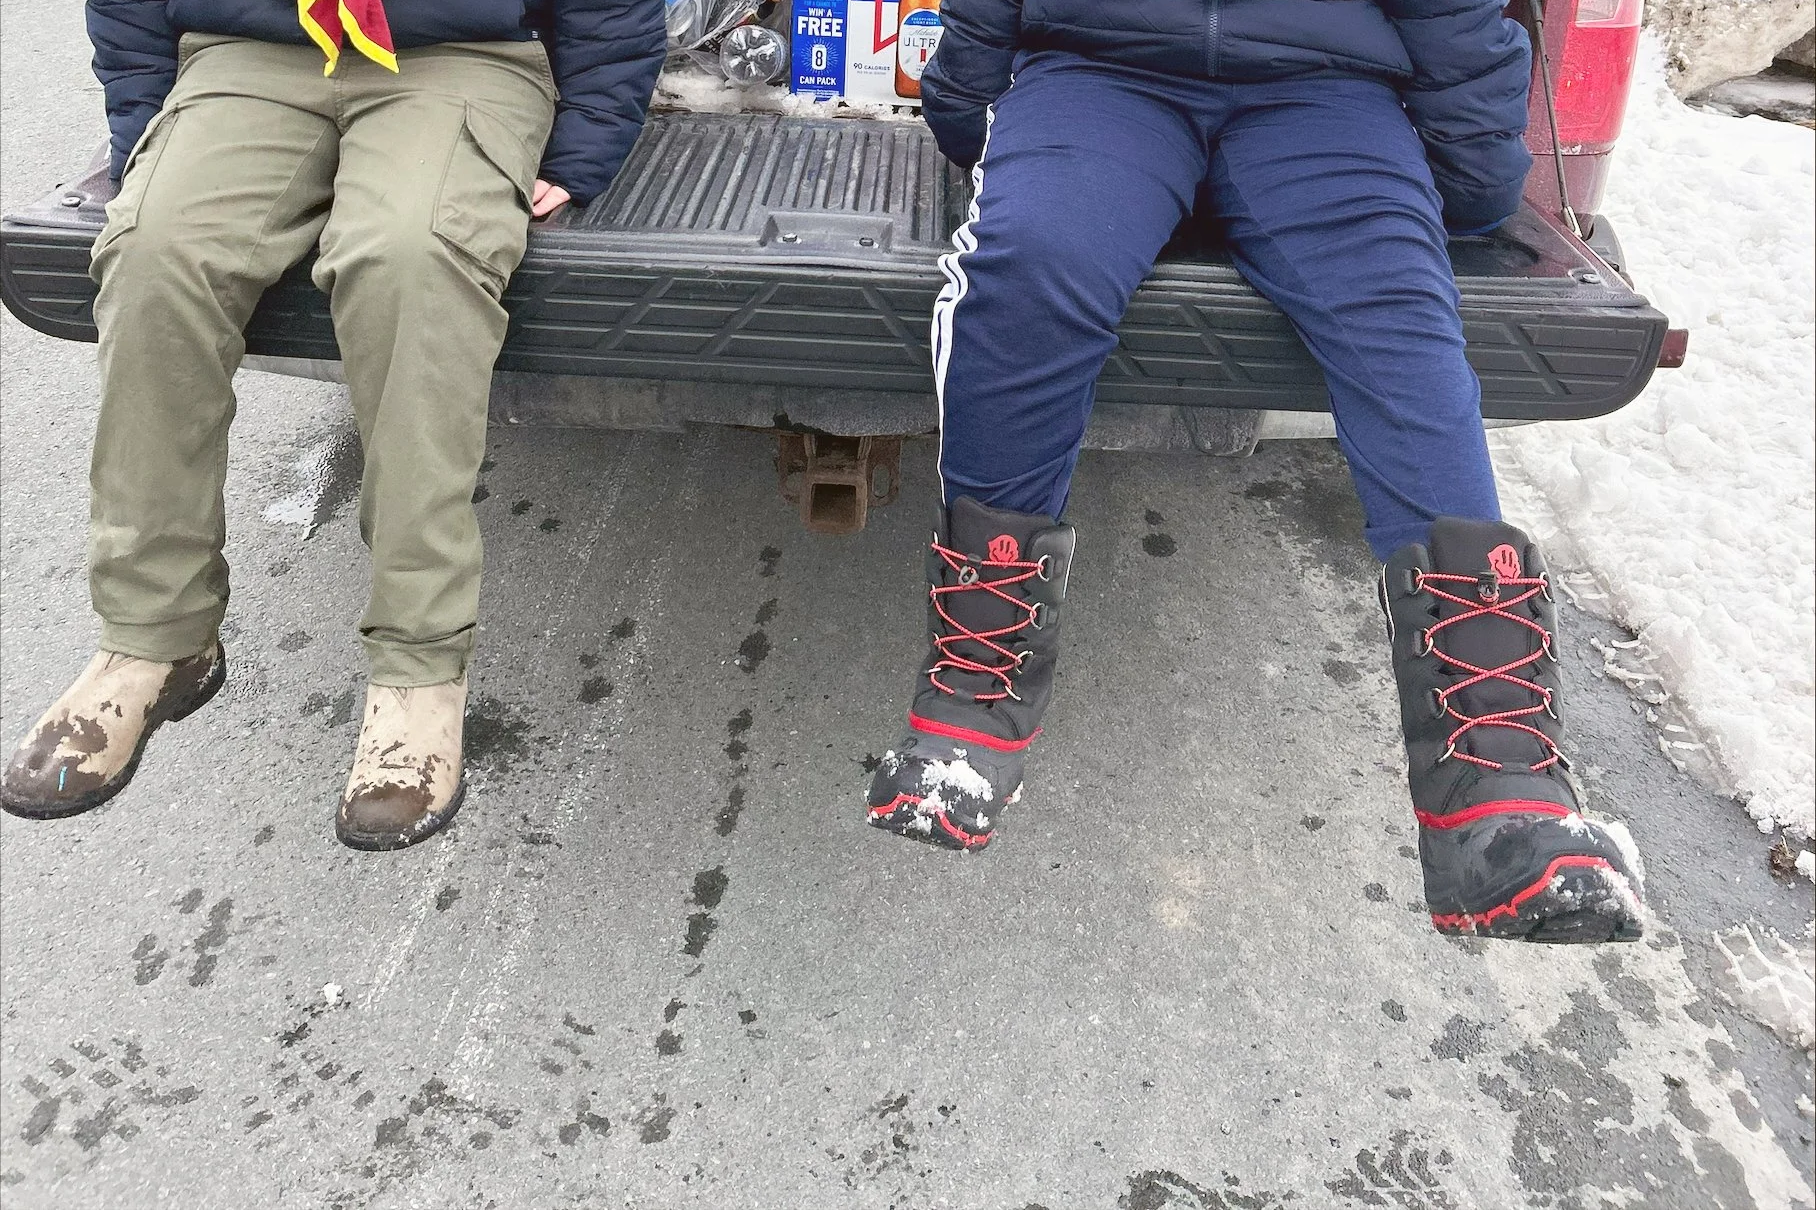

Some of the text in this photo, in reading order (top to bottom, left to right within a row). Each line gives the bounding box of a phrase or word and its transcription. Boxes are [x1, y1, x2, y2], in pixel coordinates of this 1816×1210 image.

[808, 7, 833, 18] WIN A
[797, 16, 844, 38] FREE
[903, 37, 936, 48] ULTR
[815, 50, 823, 67] 8
[853, 62, 863, 70] 90
[799, 75, 837, 86] CAN PACK
